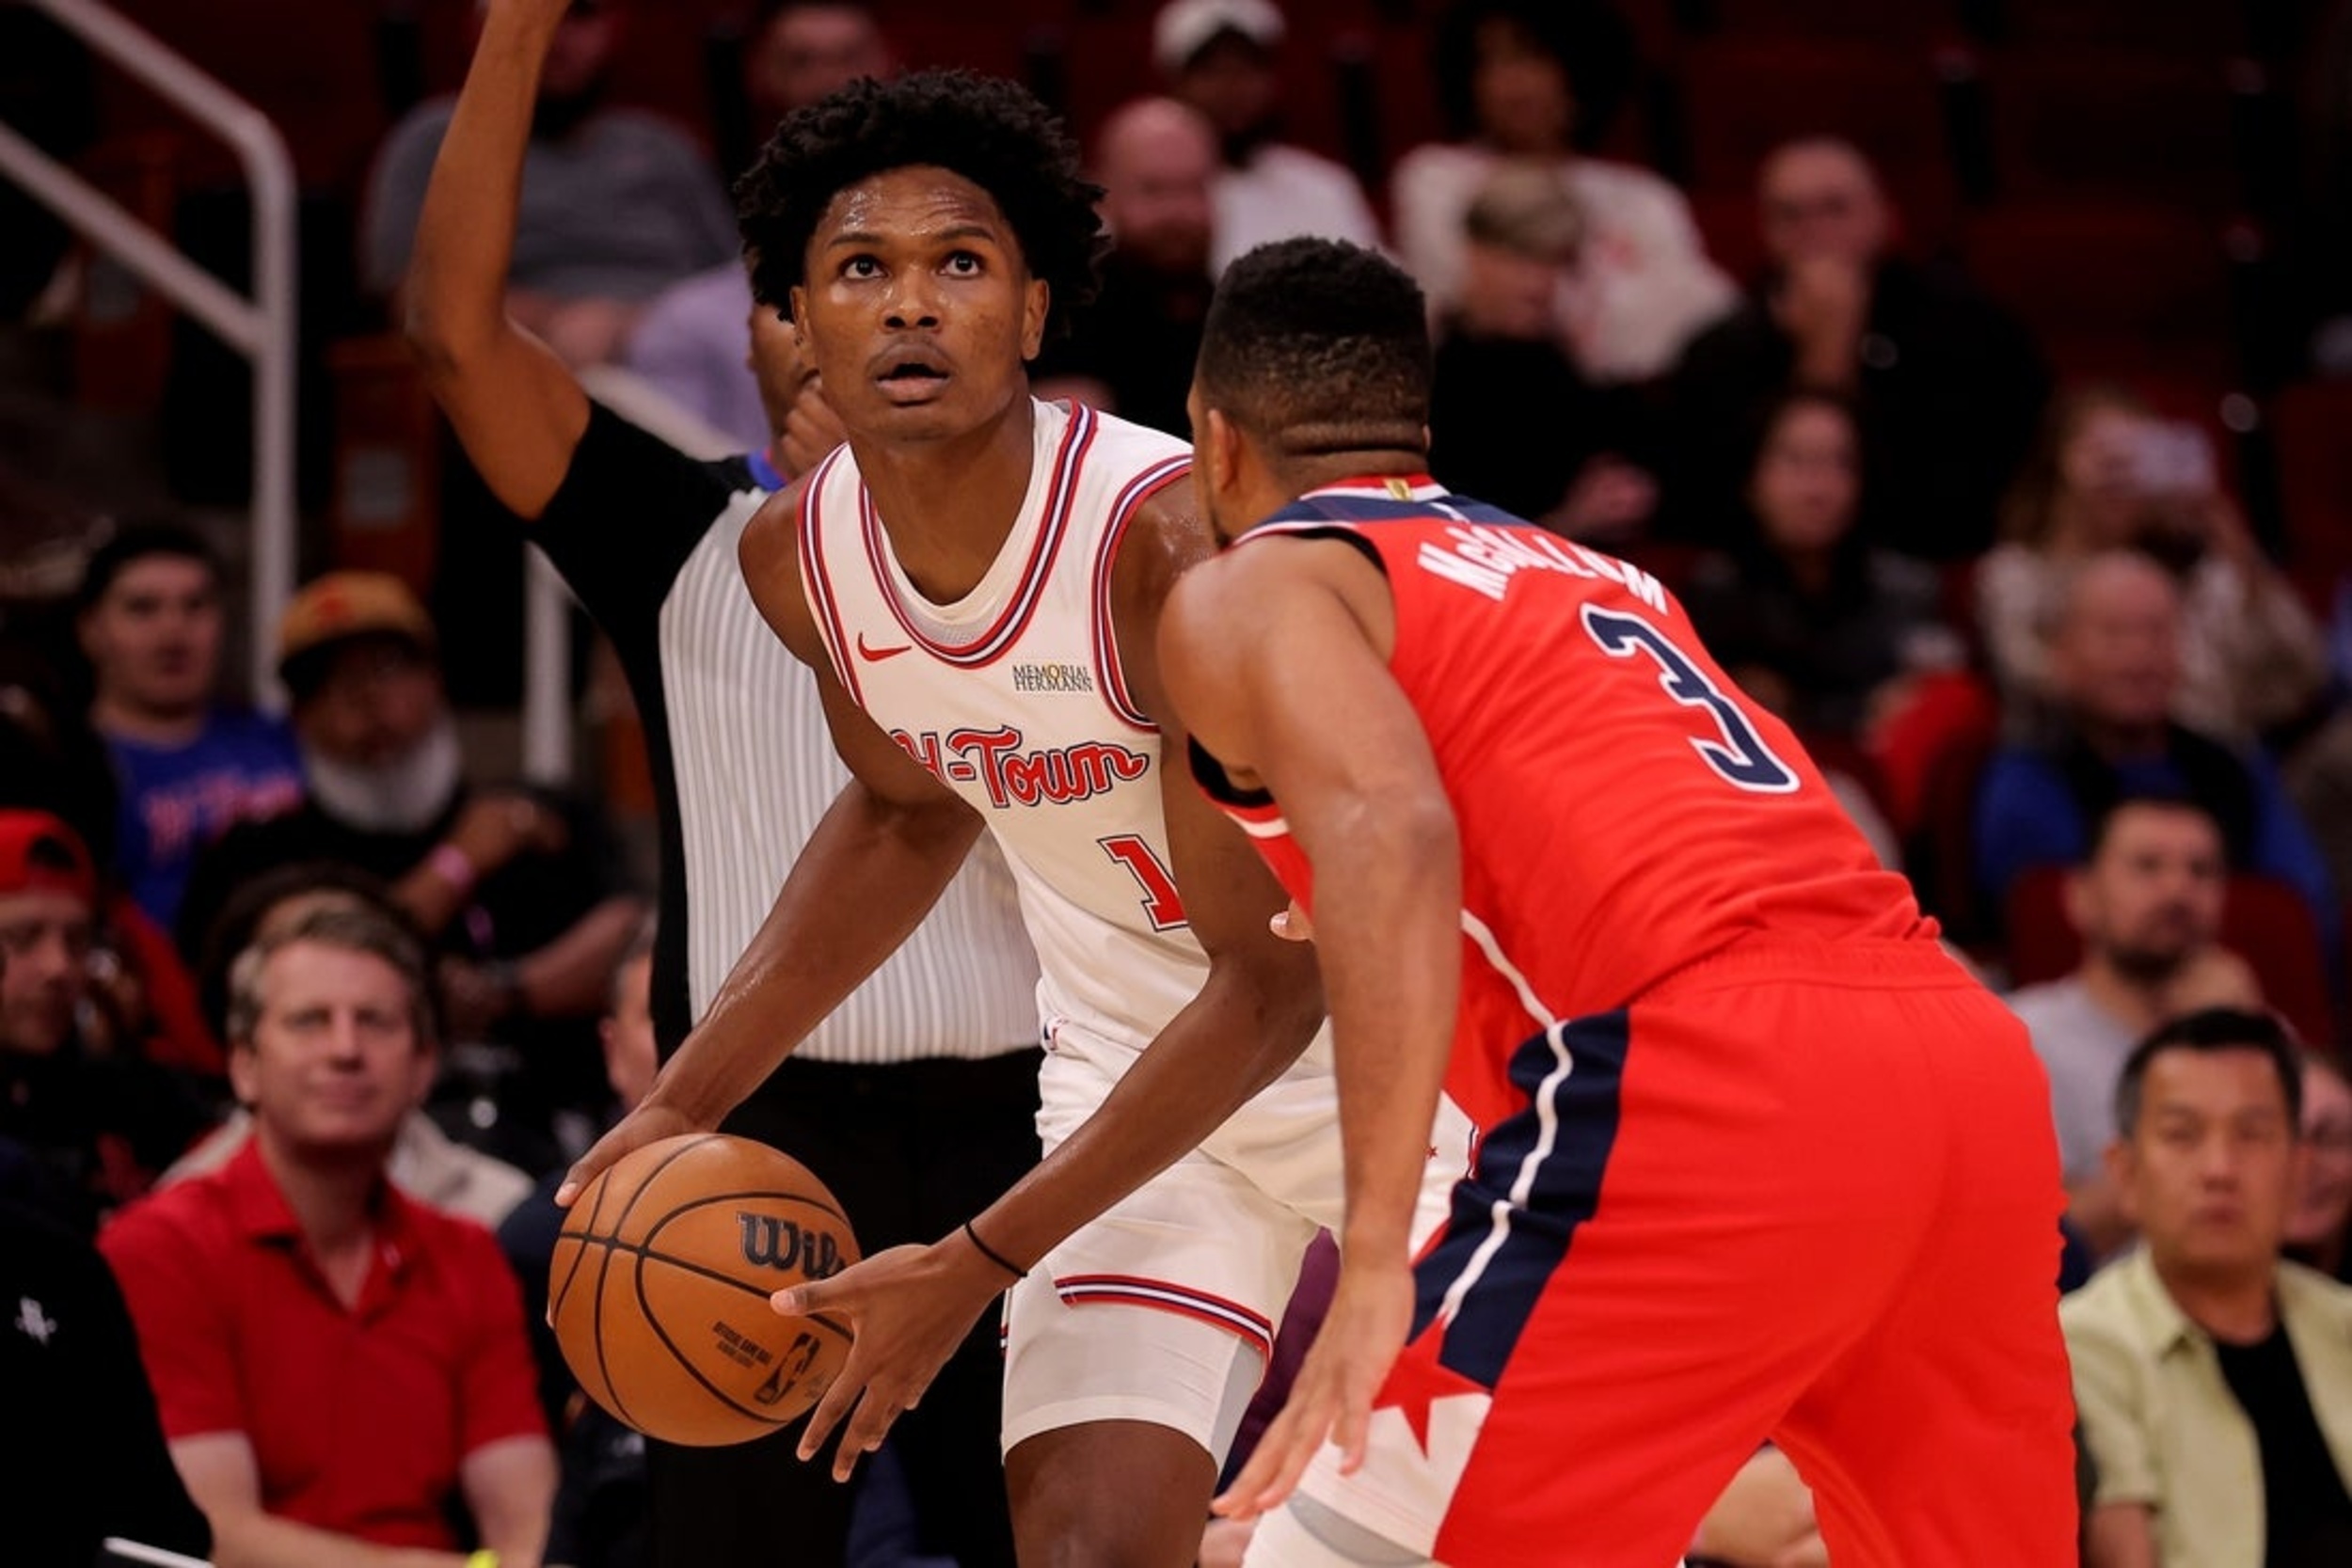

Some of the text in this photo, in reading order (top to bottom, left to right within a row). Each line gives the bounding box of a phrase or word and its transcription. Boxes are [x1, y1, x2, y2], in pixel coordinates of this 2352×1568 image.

[1012, 664, 1089, 679] MEMORIAL
[1014, 676, 1093, 692] HERMANN
[1580, 601, 1801, 793] 3
[1095, 833, 1190, 933] 1
